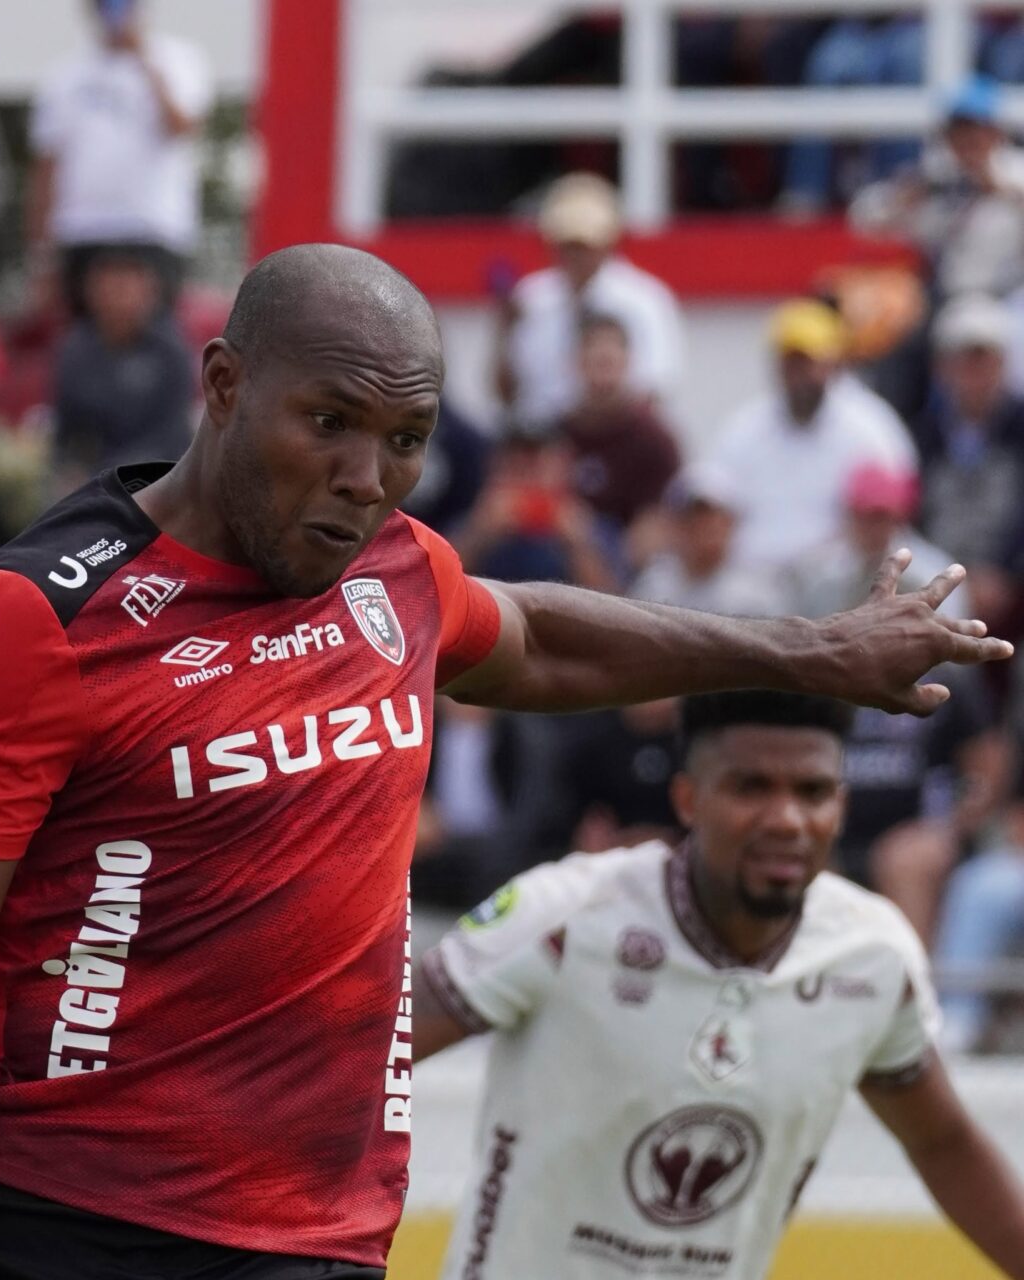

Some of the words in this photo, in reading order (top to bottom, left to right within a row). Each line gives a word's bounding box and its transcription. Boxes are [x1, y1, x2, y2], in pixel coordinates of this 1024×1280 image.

[76, 538, 109, 559] SEGUROS
[85, 540, 127, 567] UNIDOS
[347, 583, 384, 598] LEONES
[250, 623, 345, 664] SanFra
[174, 663, 233, 688] umbro
[171, 694, 424, 799] ISUZU
